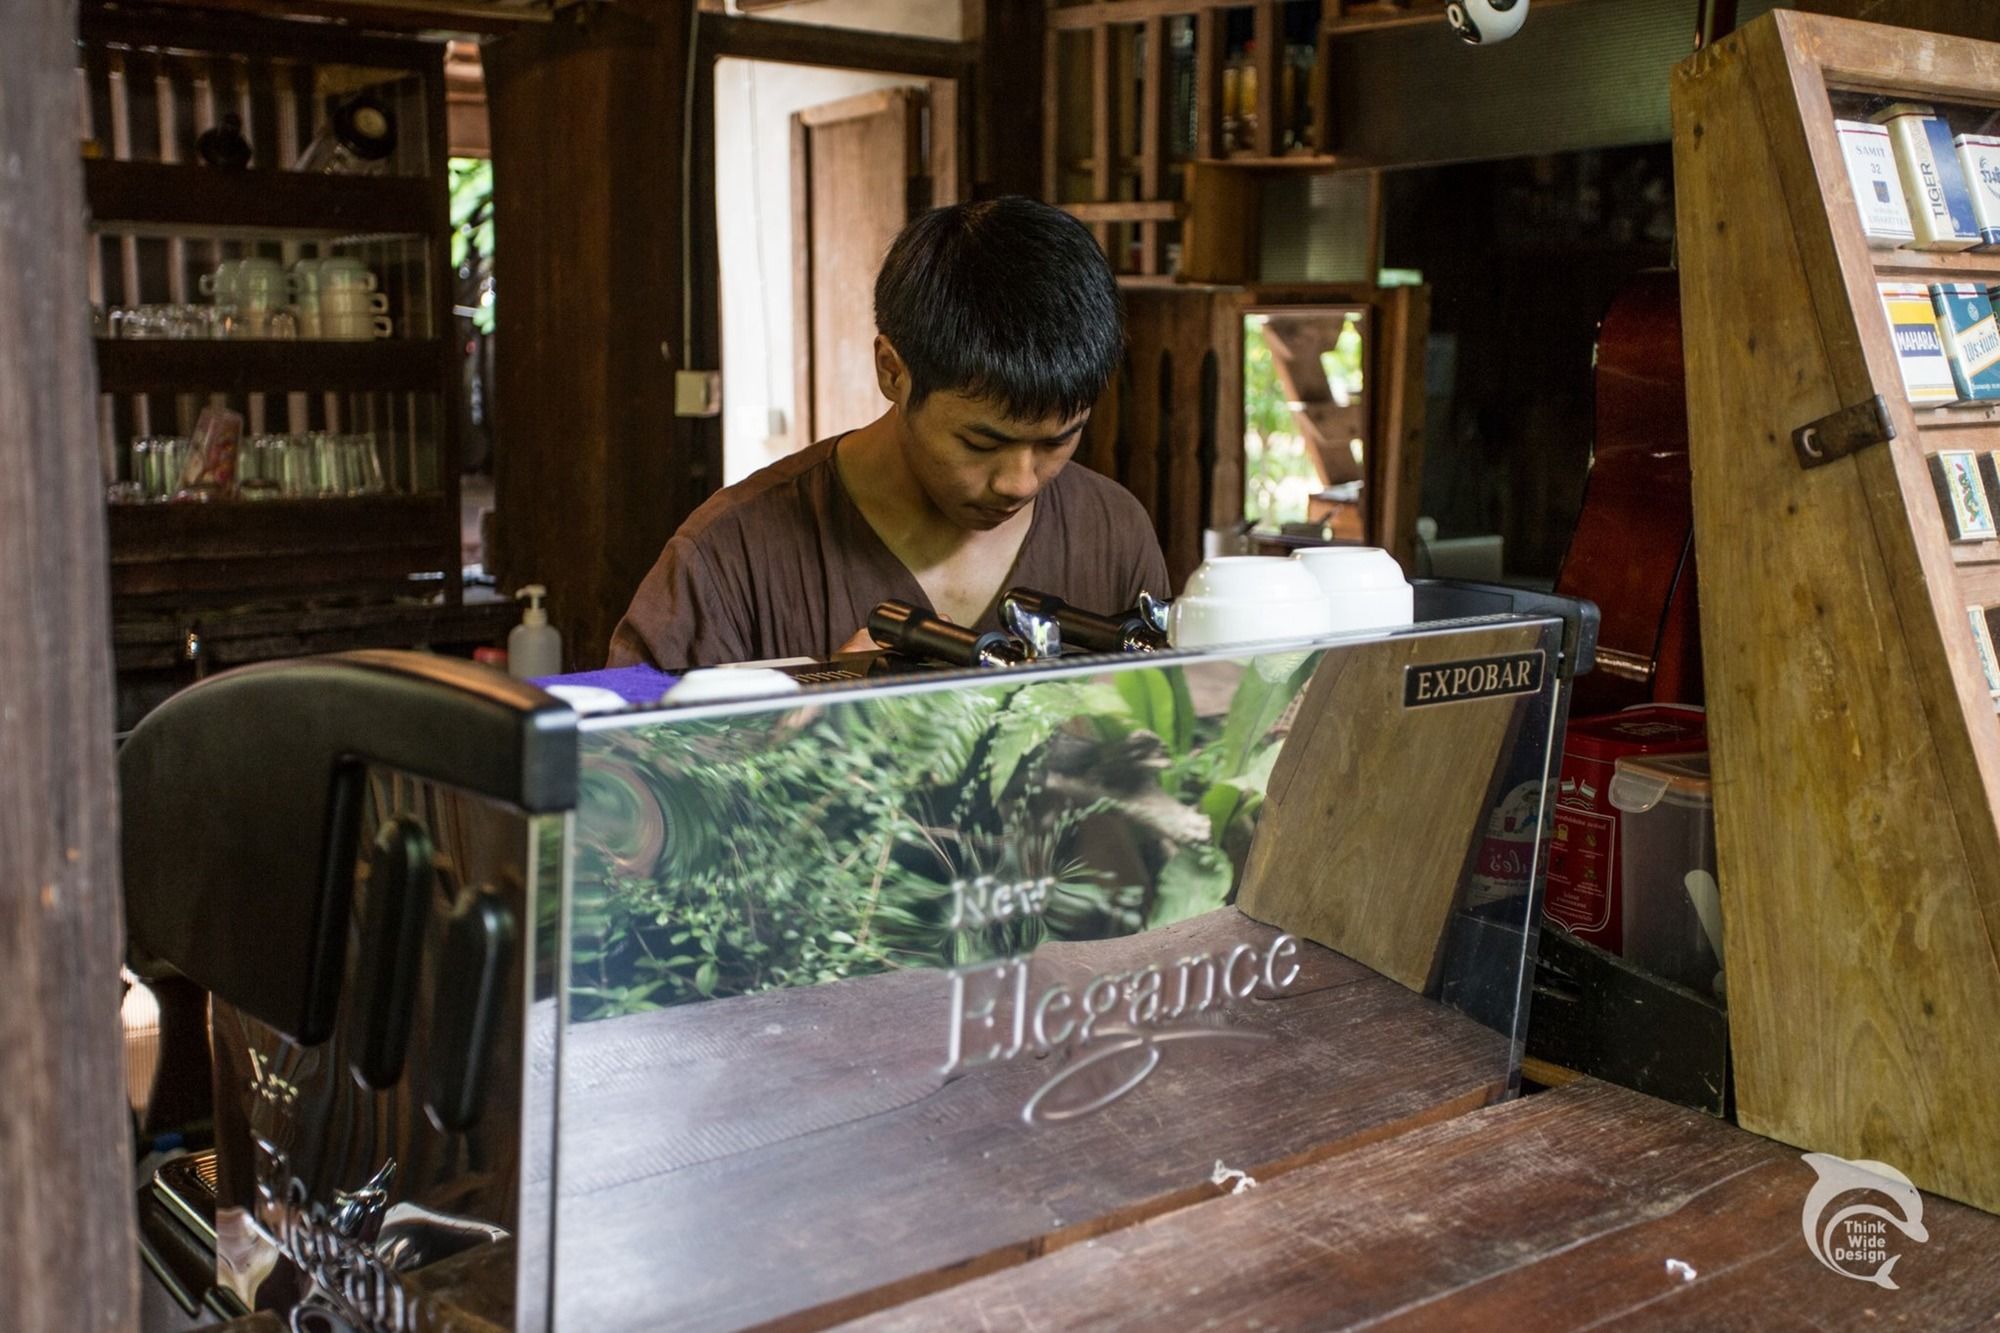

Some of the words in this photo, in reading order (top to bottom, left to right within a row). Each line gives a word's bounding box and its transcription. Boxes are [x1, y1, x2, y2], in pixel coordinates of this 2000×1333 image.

[1855, 144, 1886, 158] SAMIT
[1920, 162, 1944, 219] TIGER
[1896, 331, 1939, 351] MAHARAJ
[1417, 660, 1531, 700] EXPOBAR
[950, 874, 1057, 930] New
[940, 933, 1302, 1125] Elegance
